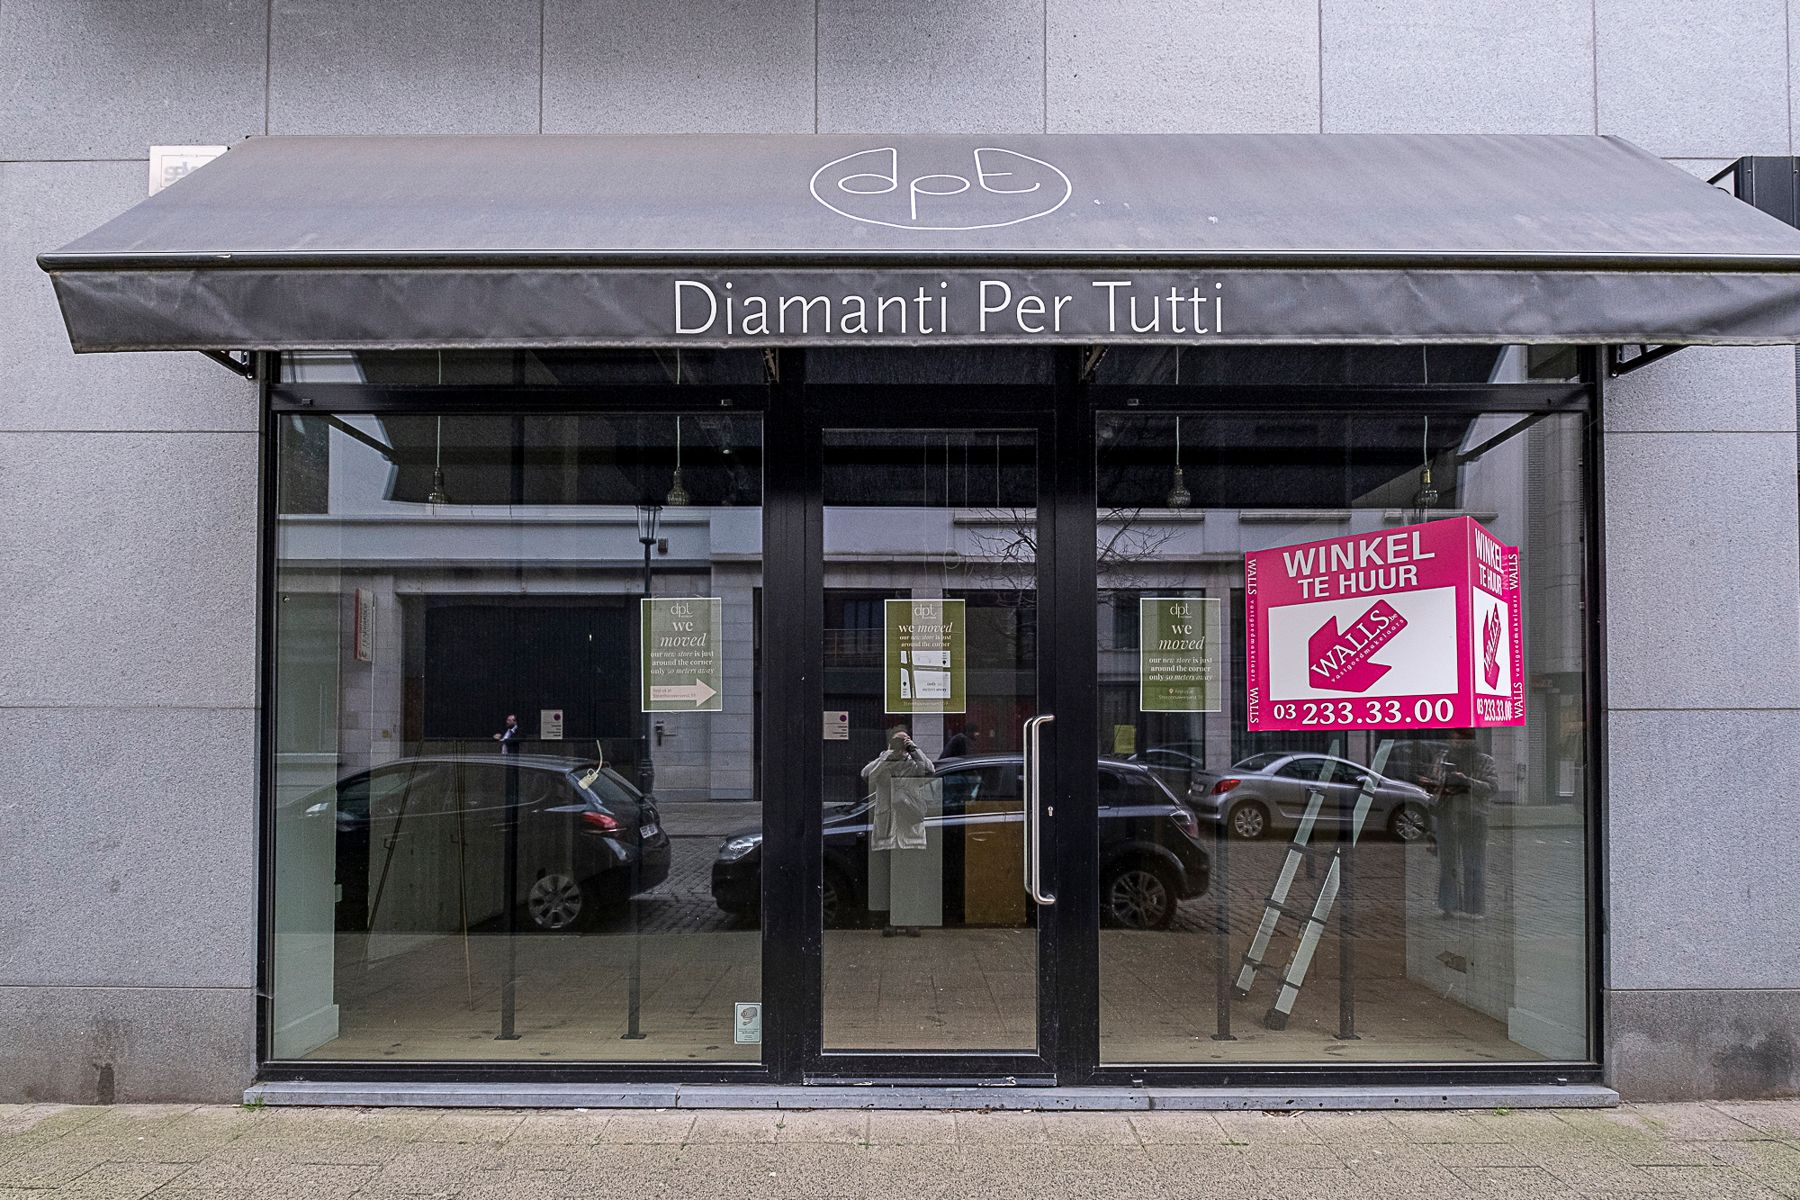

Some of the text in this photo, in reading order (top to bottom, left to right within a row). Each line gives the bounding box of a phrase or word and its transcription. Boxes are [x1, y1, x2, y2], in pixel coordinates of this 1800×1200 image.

[838, 147, 1041, 220] dpt
[674, 280, 1223, 336] Diamanti Per Tutti
[1283, 530, 1436, 578] WINKEL
[1474, 527, 1505, 575] WINKEL
[1247, 558, 1257, 595] WALLS
[1297, 564, 1419, 599] TE HUUR
[1478, 563, 1502, 596] TE HUUR
[1508, 553, 1519, 590] WALLS
[672, 621, 694, 632] we
[898, 622, 953, 633] we moved
[1169, 603, 1192, 619] dpt
[660, 633, 707, 647] moved
[1158, 636, 1205, 650] moved
[1171, 624, 1193, 635] we
[1149, 673, 1163, 681] only
[1250, 687, 1259, 724] WALLS
[1273, 698, 1454, 725] 03 233.33.00
[1513, 681, 1524, 719] WALLS
